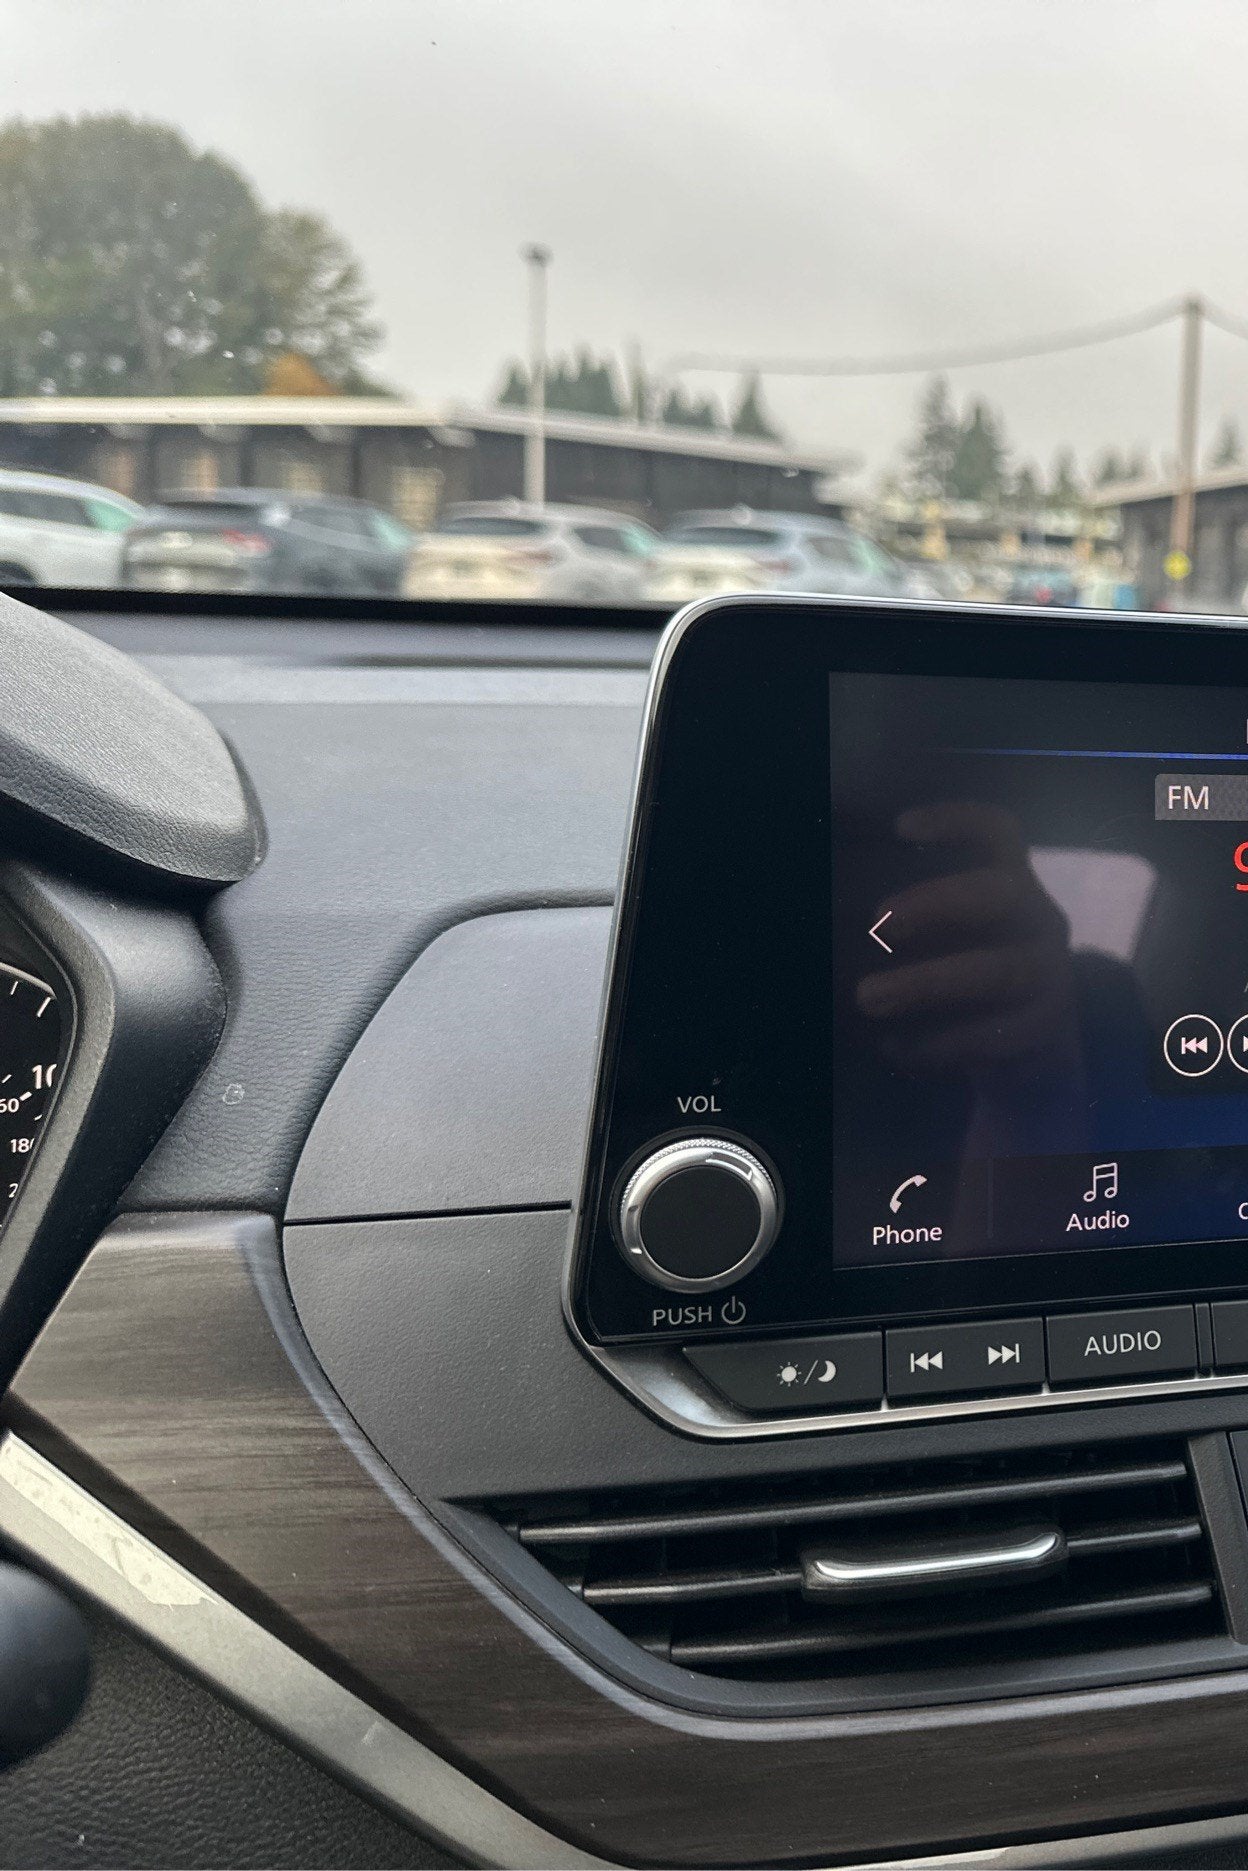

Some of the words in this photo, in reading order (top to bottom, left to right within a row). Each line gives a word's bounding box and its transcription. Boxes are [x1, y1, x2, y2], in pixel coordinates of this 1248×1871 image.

[1168, 785, 1209, 810] FM
[677, 1095, 722, 1114] VOL
[1065, 1209, 1130, 1232] Audio
[873, 1224, 943, 1246] Phone
[652, 1305, 712, 1327] PUSH
[1084, 1330, 1162, 1357] AUDIO
